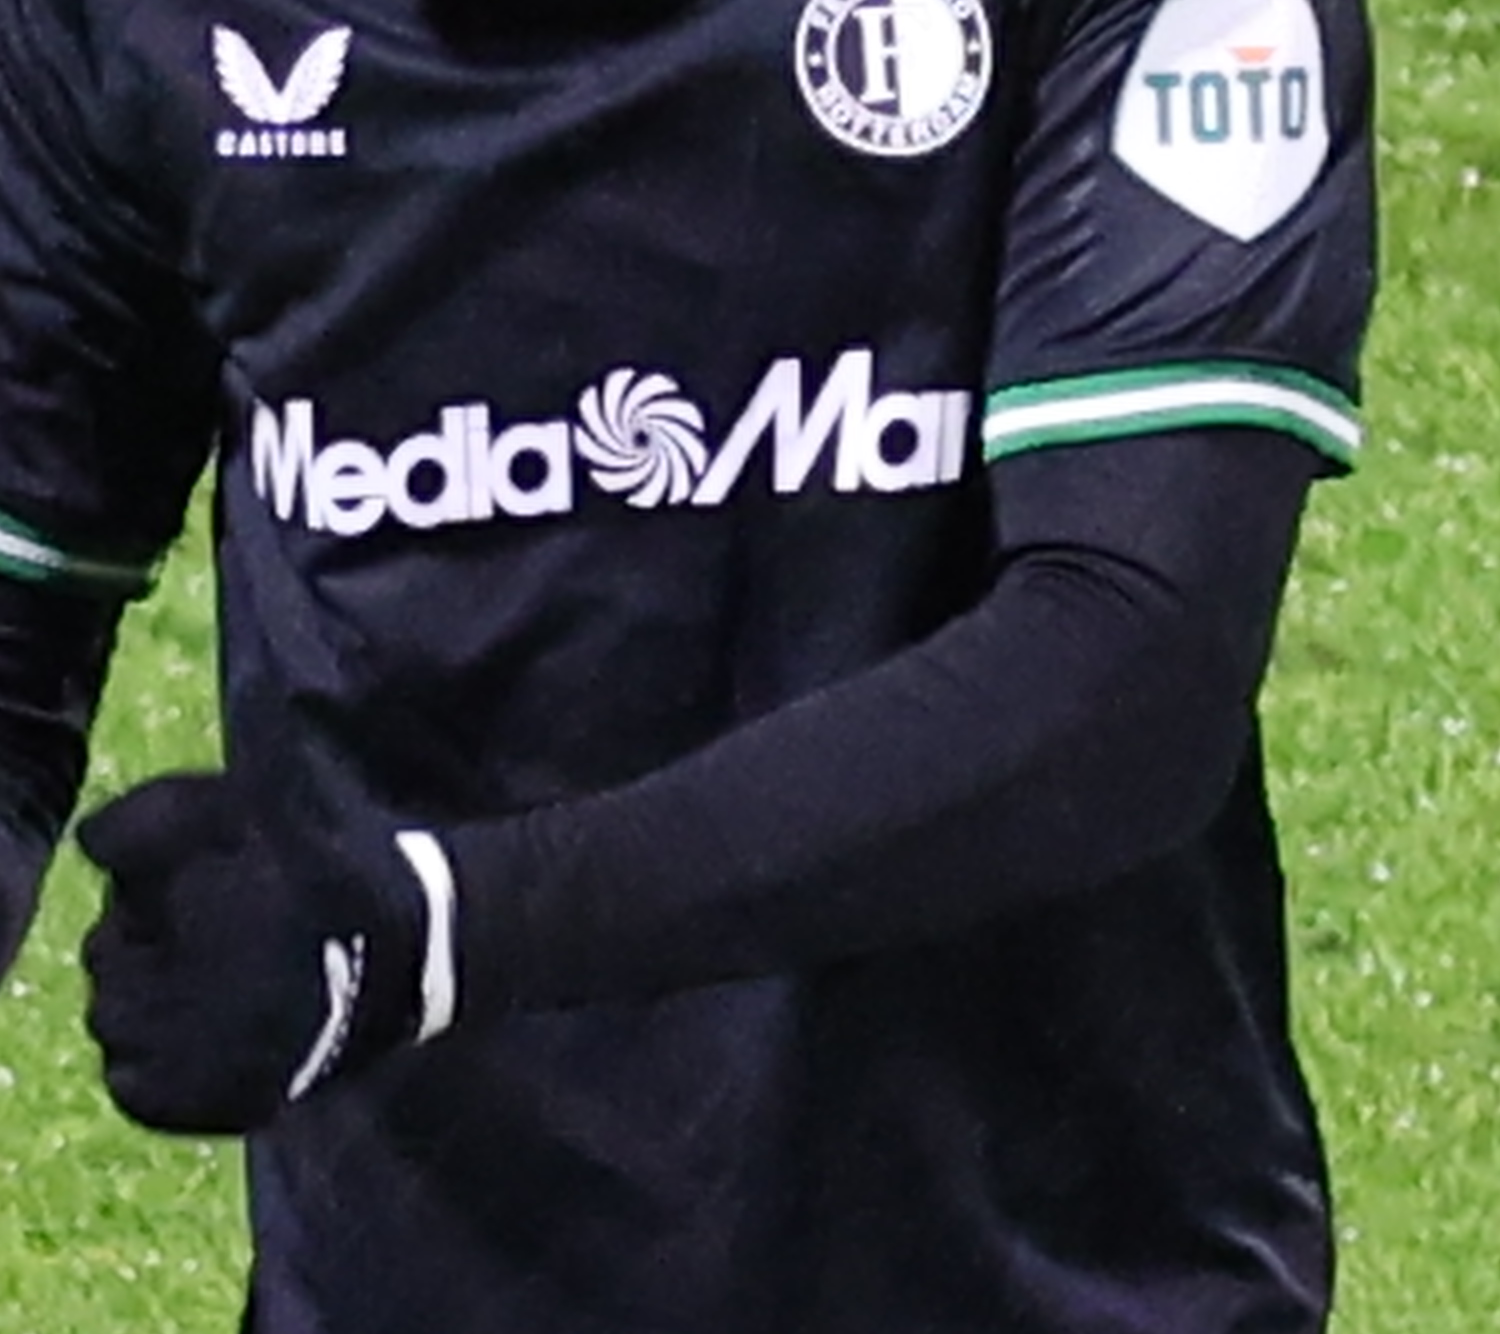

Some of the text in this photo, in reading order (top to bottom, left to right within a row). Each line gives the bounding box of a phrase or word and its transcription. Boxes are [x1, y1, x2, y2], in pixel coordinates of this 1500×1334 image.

[216, 129, 346, 157] CASTORE
[1142, 67, 1308, 146] TOTO
[252, 398, 573, 536] Media
